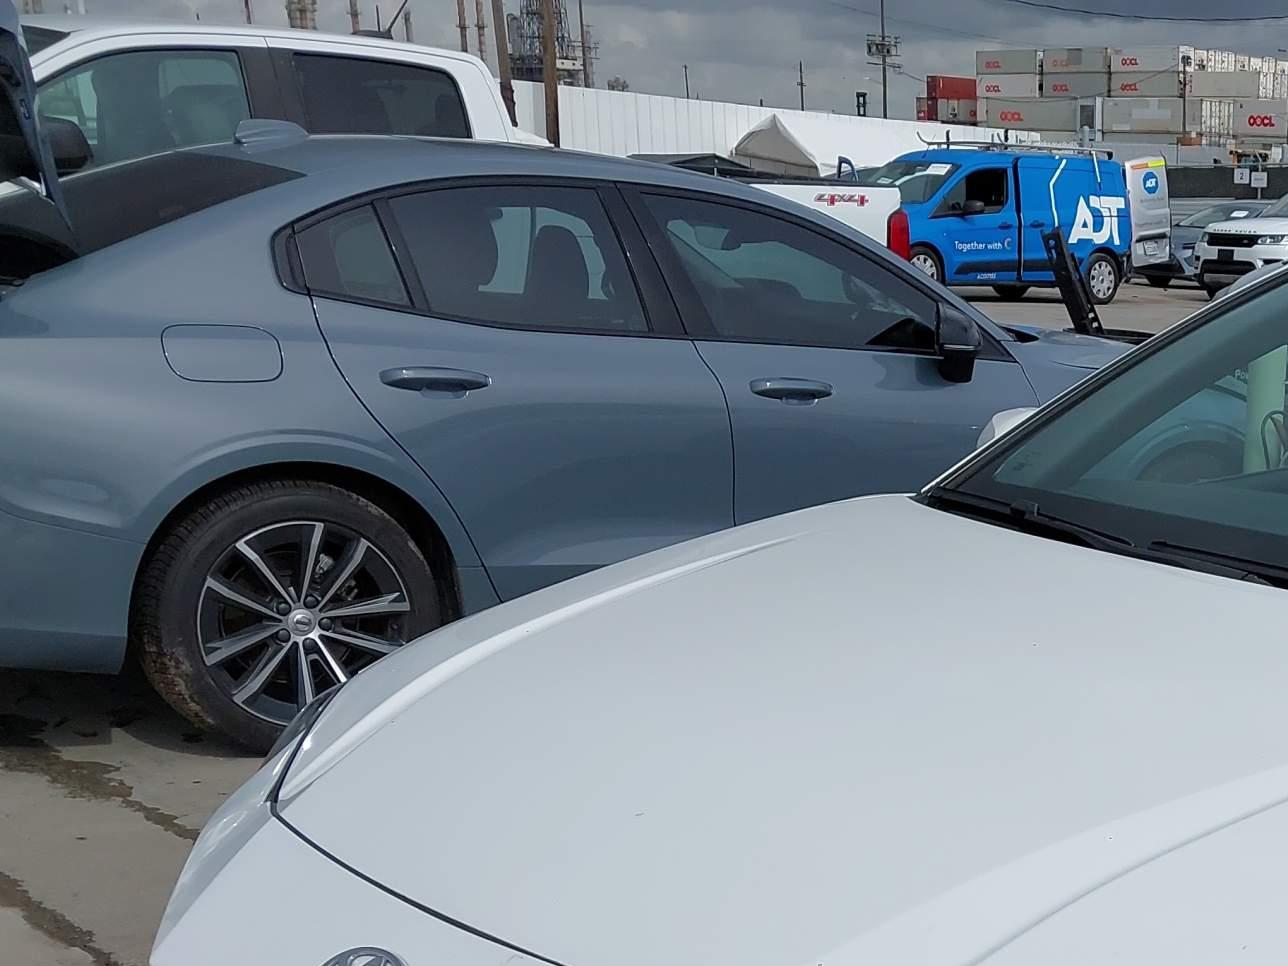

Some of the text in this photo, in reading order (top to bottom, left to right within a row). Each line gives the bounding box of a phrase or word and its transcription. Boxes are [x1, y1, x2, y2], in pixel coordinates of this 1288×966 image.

[1248, 115, 1275, 127] OOCL
[1239, 172, 1244, 180] 2
[1068, 195, 1125, 245] ADT
[954, 240, 1003, 252] Together with
